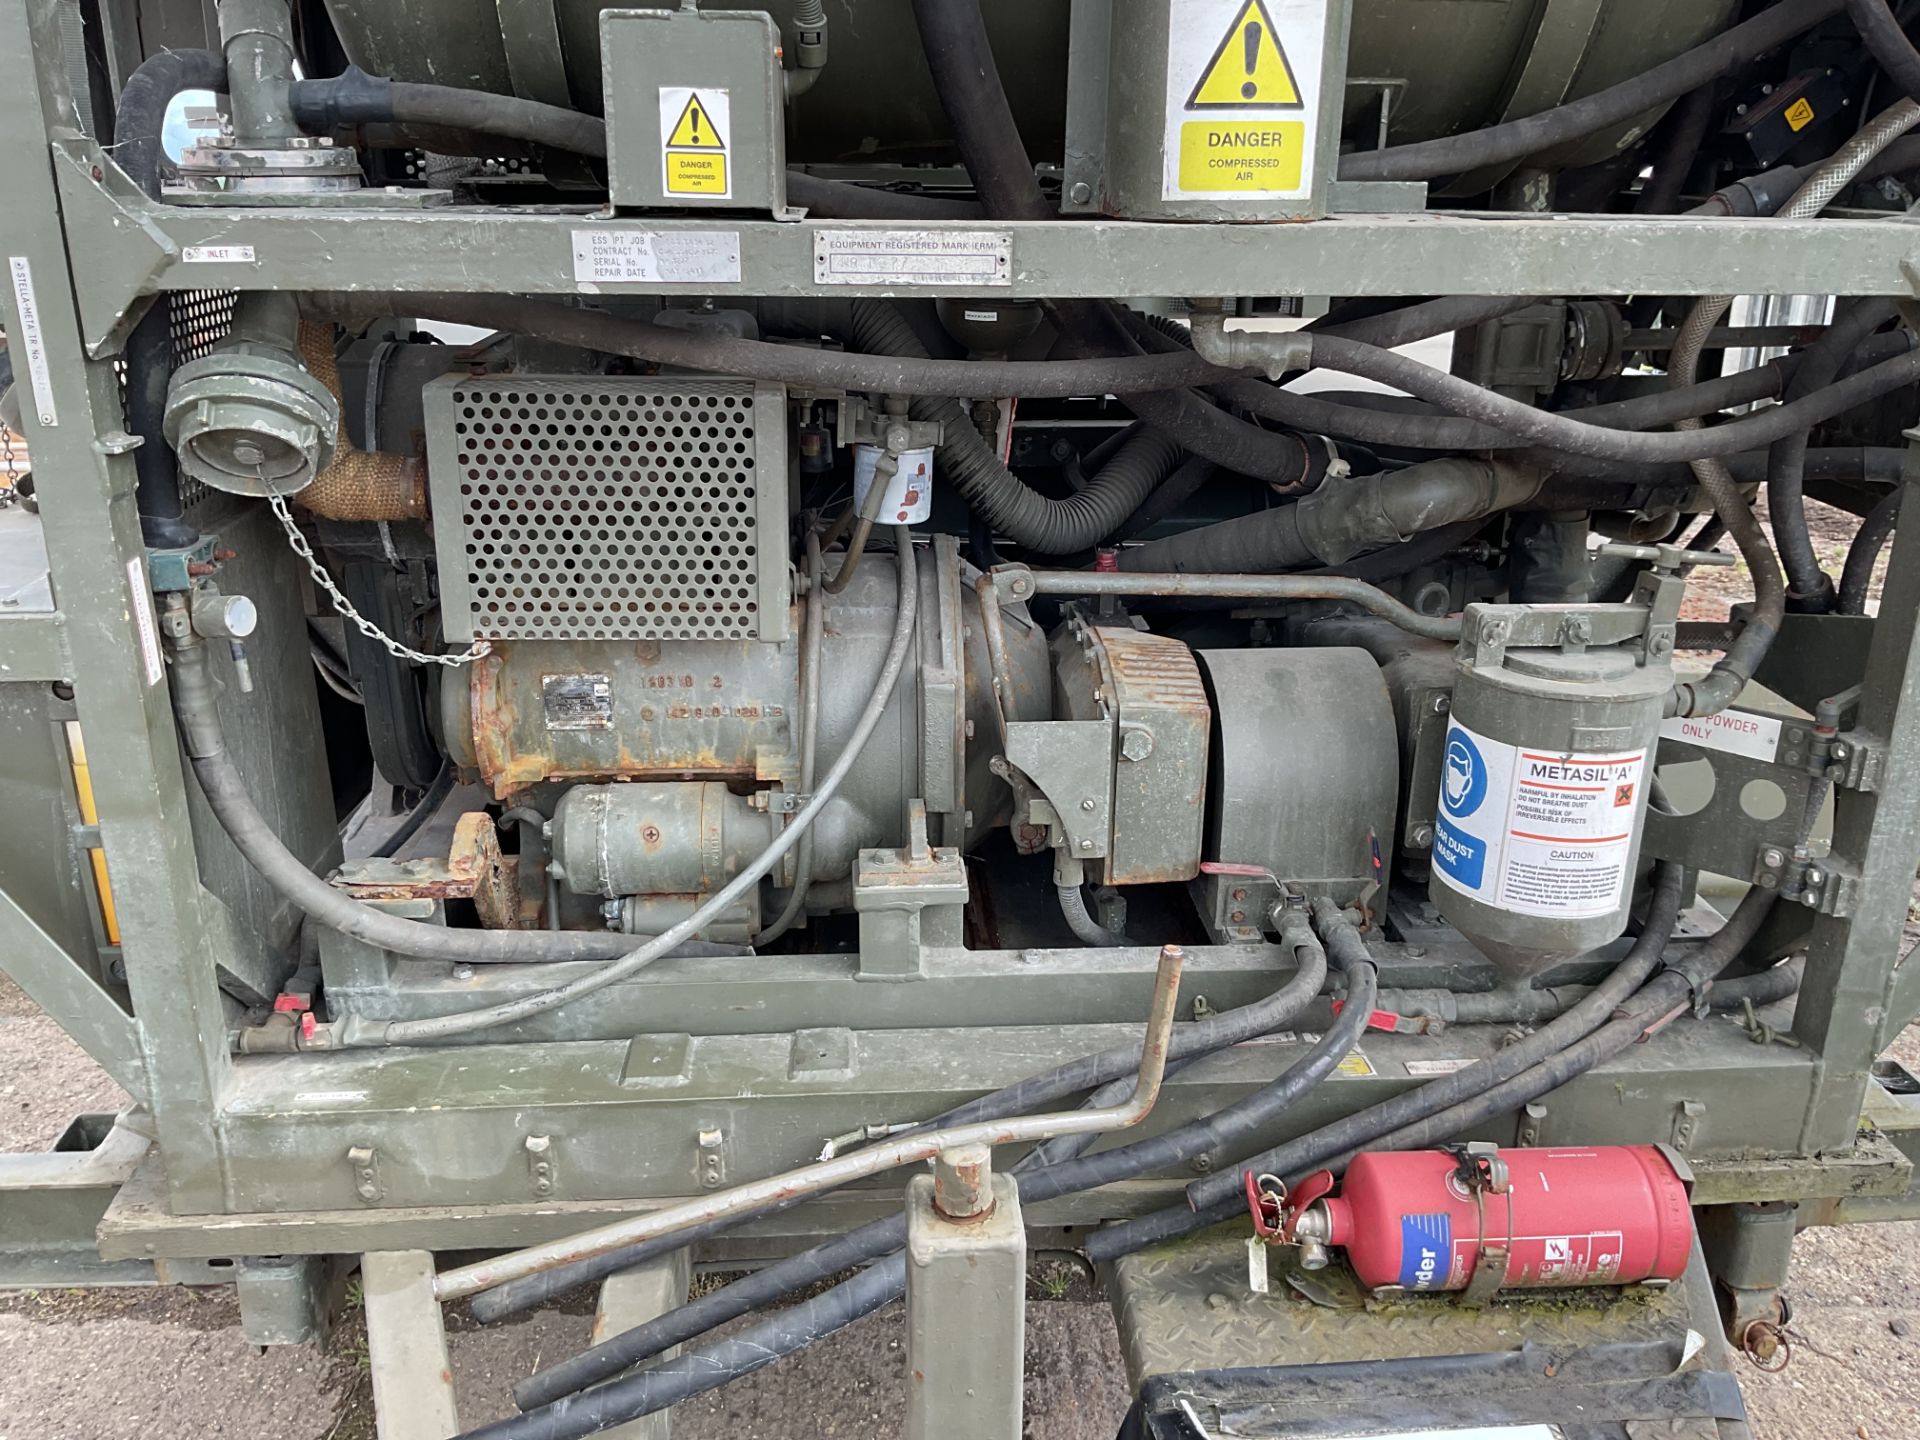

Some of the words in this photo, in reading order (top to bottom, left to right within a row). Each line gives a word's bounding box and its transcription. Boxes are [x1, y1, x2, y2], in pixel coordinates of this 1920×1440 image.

[1208, 132, 1282, 147] DANGER
[680, 161, 712, 169] DANGER
[1208, 159, 1279, 168] COMPRESSED
[1235, 172, 1253, 181] AIR
[592, 236, 608, 245] ESS
[612, 236, 624, 245] IPT
[630, 236, 645, 245] JOB
[830, 241, 882, 249] EQUIPMENT
[885, 241, 939, 250] REGISTERED
[942, 242, 968, 250] MARK
[972, 242, 997, 250] (ERM)
[207, 249, 228, 258] INLET
[593, 247, 632, 255] CONTRACT
[637, 247, 650, 256] No.
[594, 257, 621, 266] SERIAL
[595, 268, 622, 277] REPAIR
[627, 268, 646, 277] DATE
[16, 272, 35, 330] STELLA-META
[28, 334, 38, 345] TR
[1682, 723, 1712, 740] ONLY
[1705, 715, 1759, 736] POWDER
[1530, 763, 1609, 782] METASIL
[1519, 787, 1549, 798] HARMFUL
[1560, 793, 1597, 801] INHALATION
[1518, 794, 1527, 802] DO
[1528, 796, 1541, 804] NOT
[1542, 798, 1570, 807] BREATHE
[1572, 801, 1588, 809] DUST
[1516, 804, 1547, 815] POSSIBLE
[1548, 808, 1562, 816] RISK
[1516, 811, 1559, 823] IRREVERSIBLE
[1560, 817, 1587, 825] EFFECTS
[1437, 841, 1457, 866] MASK
[1448, 837, 1474, 859] DUST
[1550, 850, 1594, 859] CAUTION
